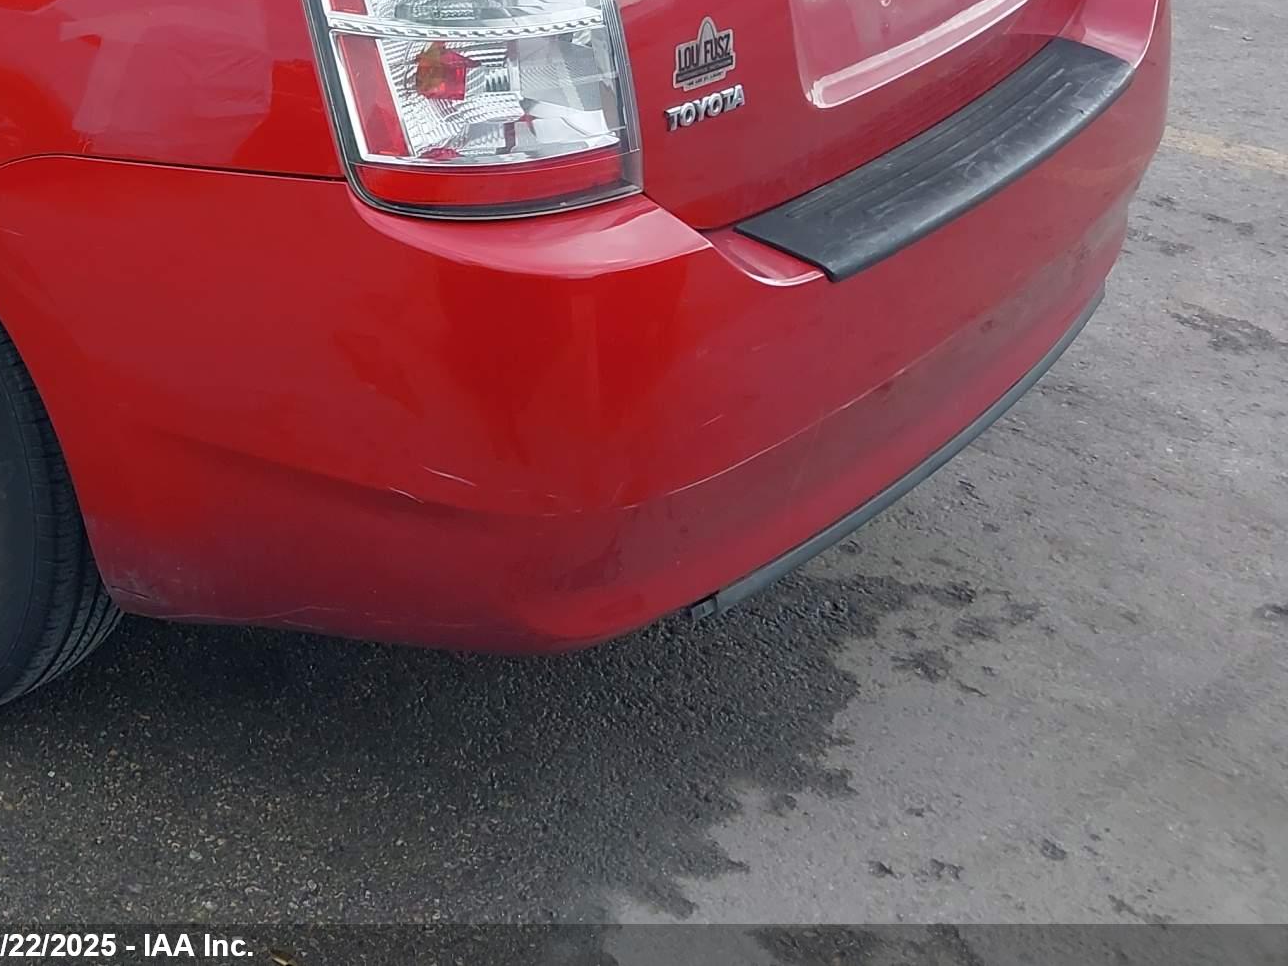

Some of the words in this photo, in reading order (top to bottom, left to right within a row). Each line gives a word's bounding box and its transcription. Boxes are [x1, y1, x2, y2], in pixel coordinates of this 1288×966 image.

[678, 42, 700, 71] LOU
[704, 33, 731, 63] FUSZ
[664, 84, 745, 132] TOYOTA
